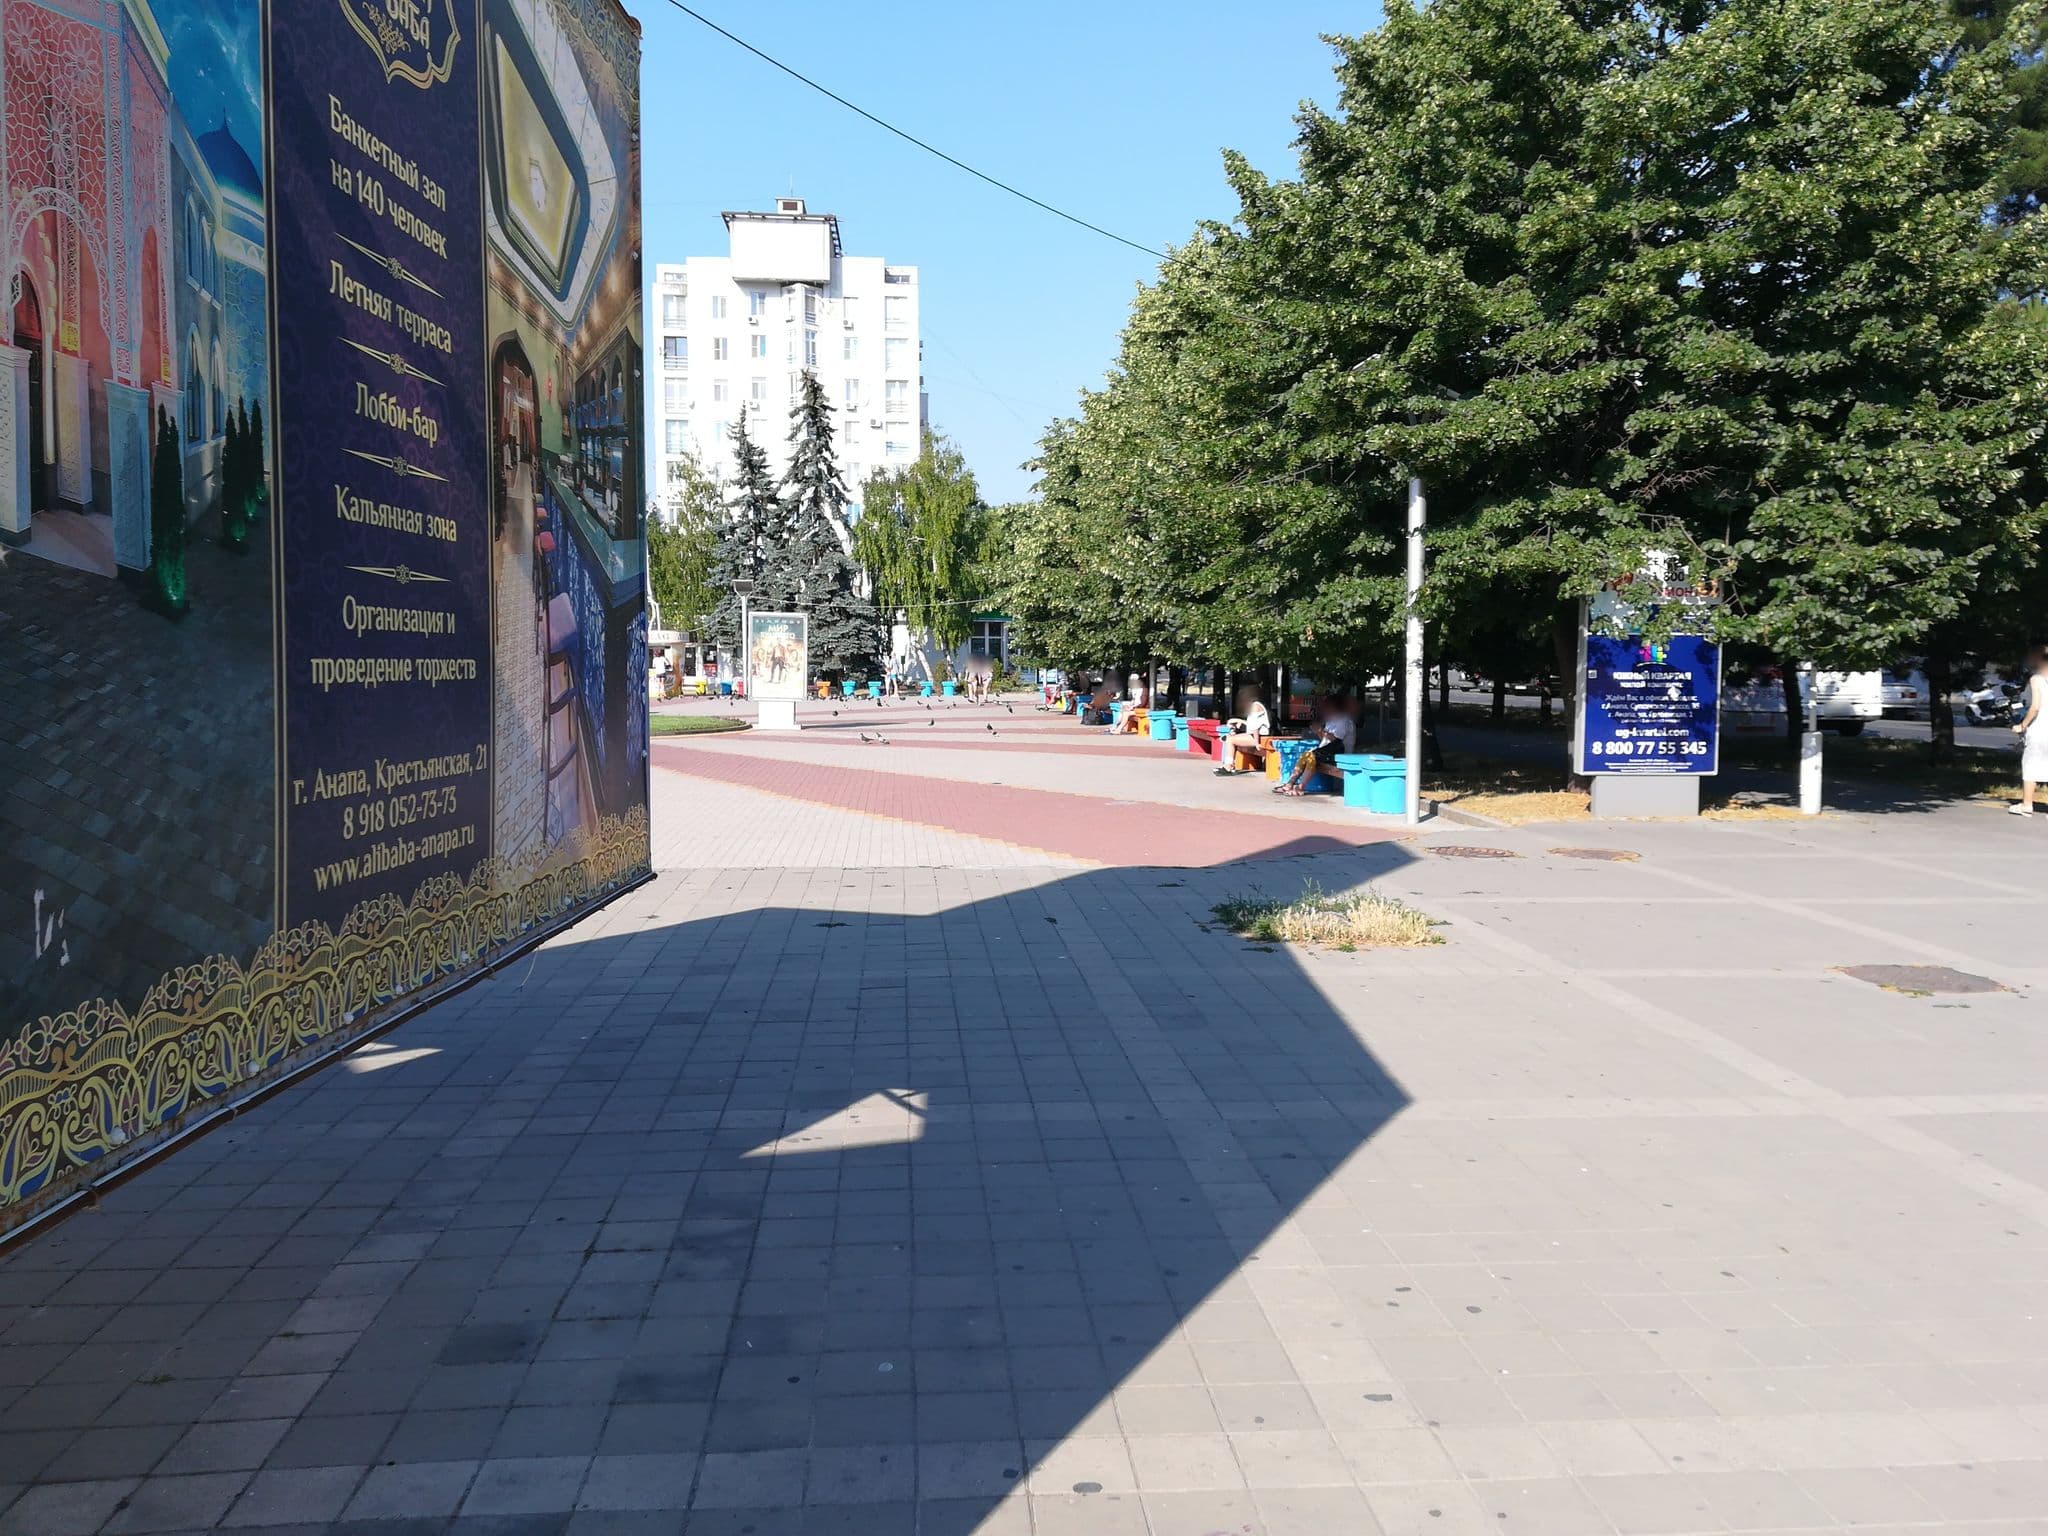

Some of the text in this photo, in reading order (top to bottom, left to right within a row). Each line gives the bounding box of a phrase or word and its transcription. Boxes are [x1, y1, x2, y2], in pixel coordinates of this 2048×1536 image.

[329, 93, 446, 212] Банкетный зал
[330, 158, 447, 259] на 140 человек
[330, 259, 452, 354] Летняя терраса
[355, 382, 438, 448] Лобби-бар
[335, 484, 457, 542] Кальянная зона
[342, 595, 456, 639] Организация и
[310, 658, 477, 693] проведение торжеств
[293, 743, 488, 805] г. Анапа, Крестьянская, 21
[1592, 741, 1708, 755] 8 800 77 55 345
[343, 785, 457, 840] 8 918 052-73-73
[313, 824, 475, 892] www.alibaba-anapa.ru
